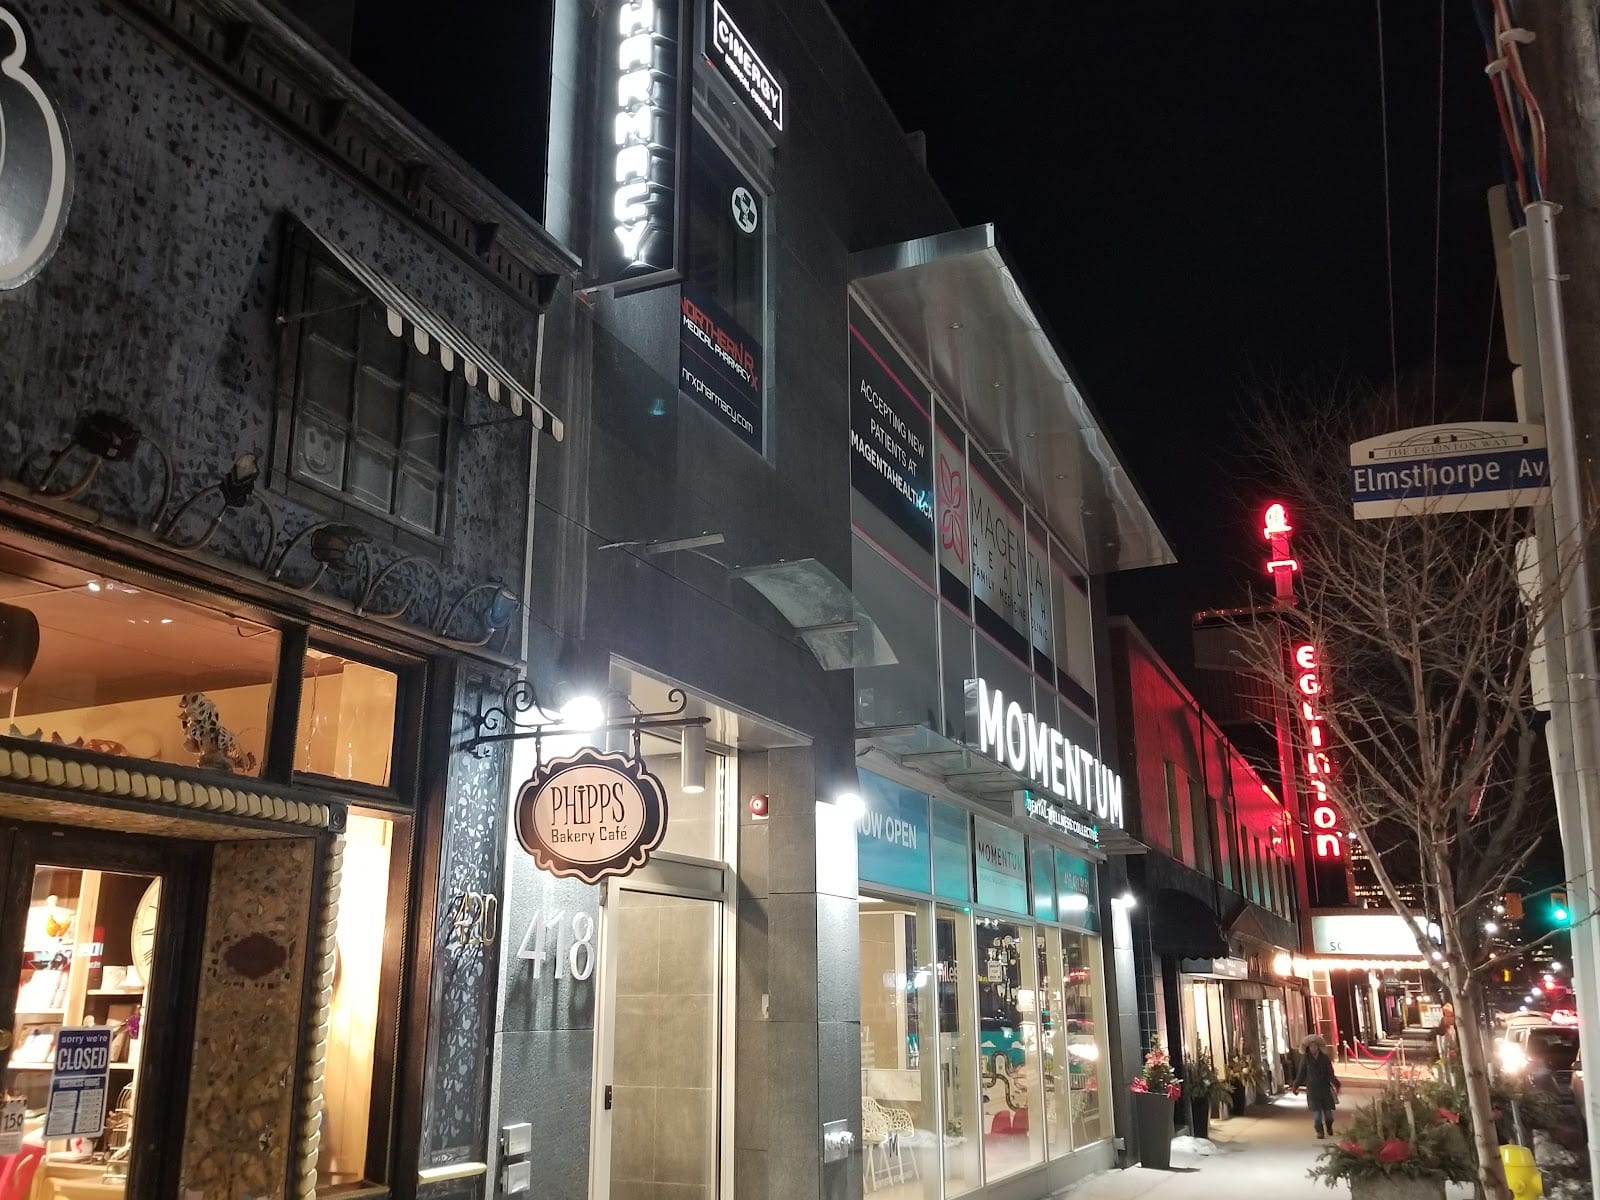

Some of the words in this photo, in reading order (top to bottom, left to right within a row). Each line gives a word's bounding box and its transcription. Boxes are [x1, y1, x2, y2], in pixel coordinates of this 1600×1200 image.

[718, 20, 779, 109] CINERGY
[683, 314, 715, 351] MEDICAL
[714, 343, 751, 383] PHARMACY
[682, 367, 754, 435] nrxpharmacy.com
[860, 379, 907, 440] ACCEPTING
[907, 429, 925, 458] NEW
[870, 418, 908, 468] PATIENTS
[907, 458, 917, 478] AT
[1482, 438, 1508, 448] WAY
[1353, 461, 1501, 492] Elmsthorpe
[1517, 458, 1545, 478] Av
[970, 488, 1045, 597] MAGENTA
[977, 677, 1124, 829] MOMENTUM
[550, 782, 626, 826] PHIPPS
[551, 828, 595, 844] Bakery
[599, 826, 628, 841] Café
[885, 816, 918, 849] OPEN
[978, 840, 1024, 872] MOMENTUM
[453, 891, 498, 947] 420
[516, 909, 595, 981] 418
[57, 1047, 108, 1071] CLOSED
[61, 1036, 85, 1044] sorry
[86, 1034, 108, 1042] we're
